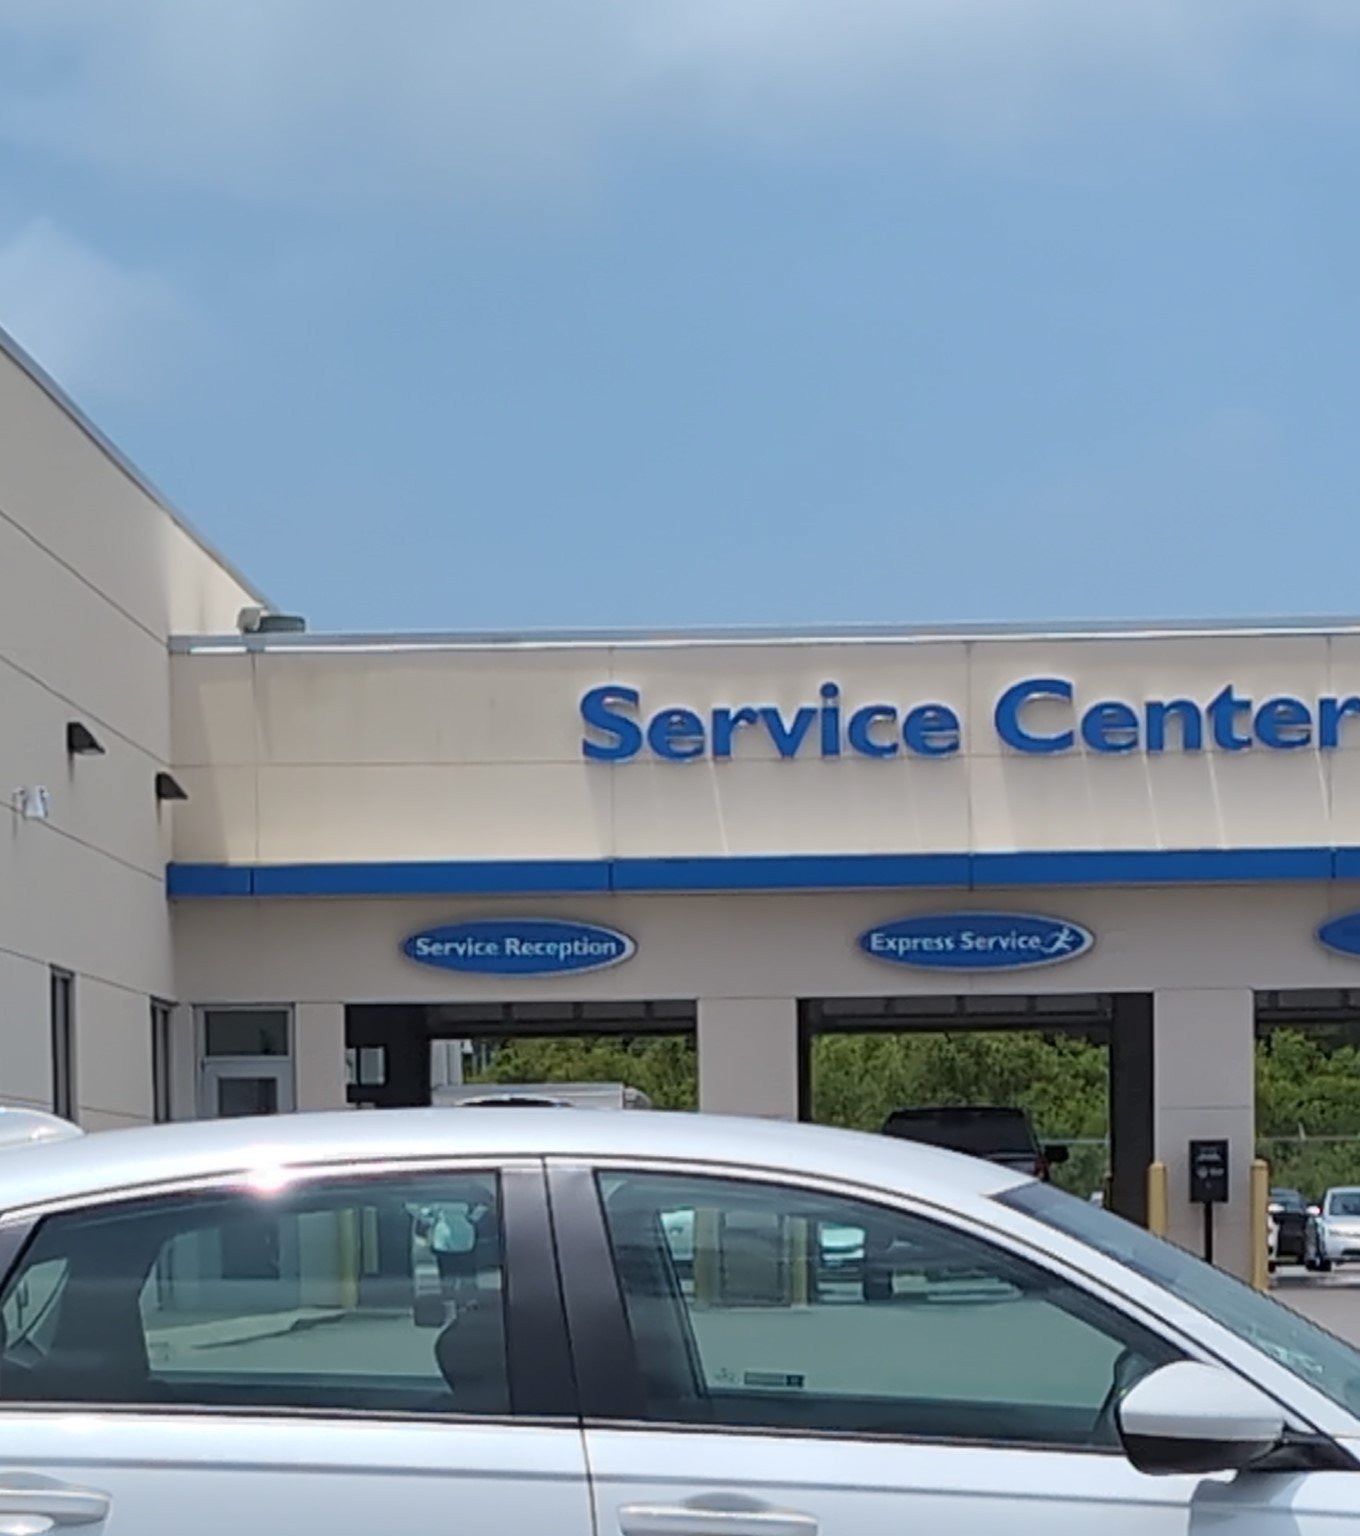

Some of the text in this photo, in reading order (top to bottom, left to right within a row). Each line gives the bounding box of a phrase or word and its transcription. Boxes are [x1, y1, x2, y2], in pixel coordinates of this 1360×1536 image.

[581, 682, 961, 761] Service
[415, 936, 617, 961] Service Reception
[870, 930, 1041, 957] Express Service
